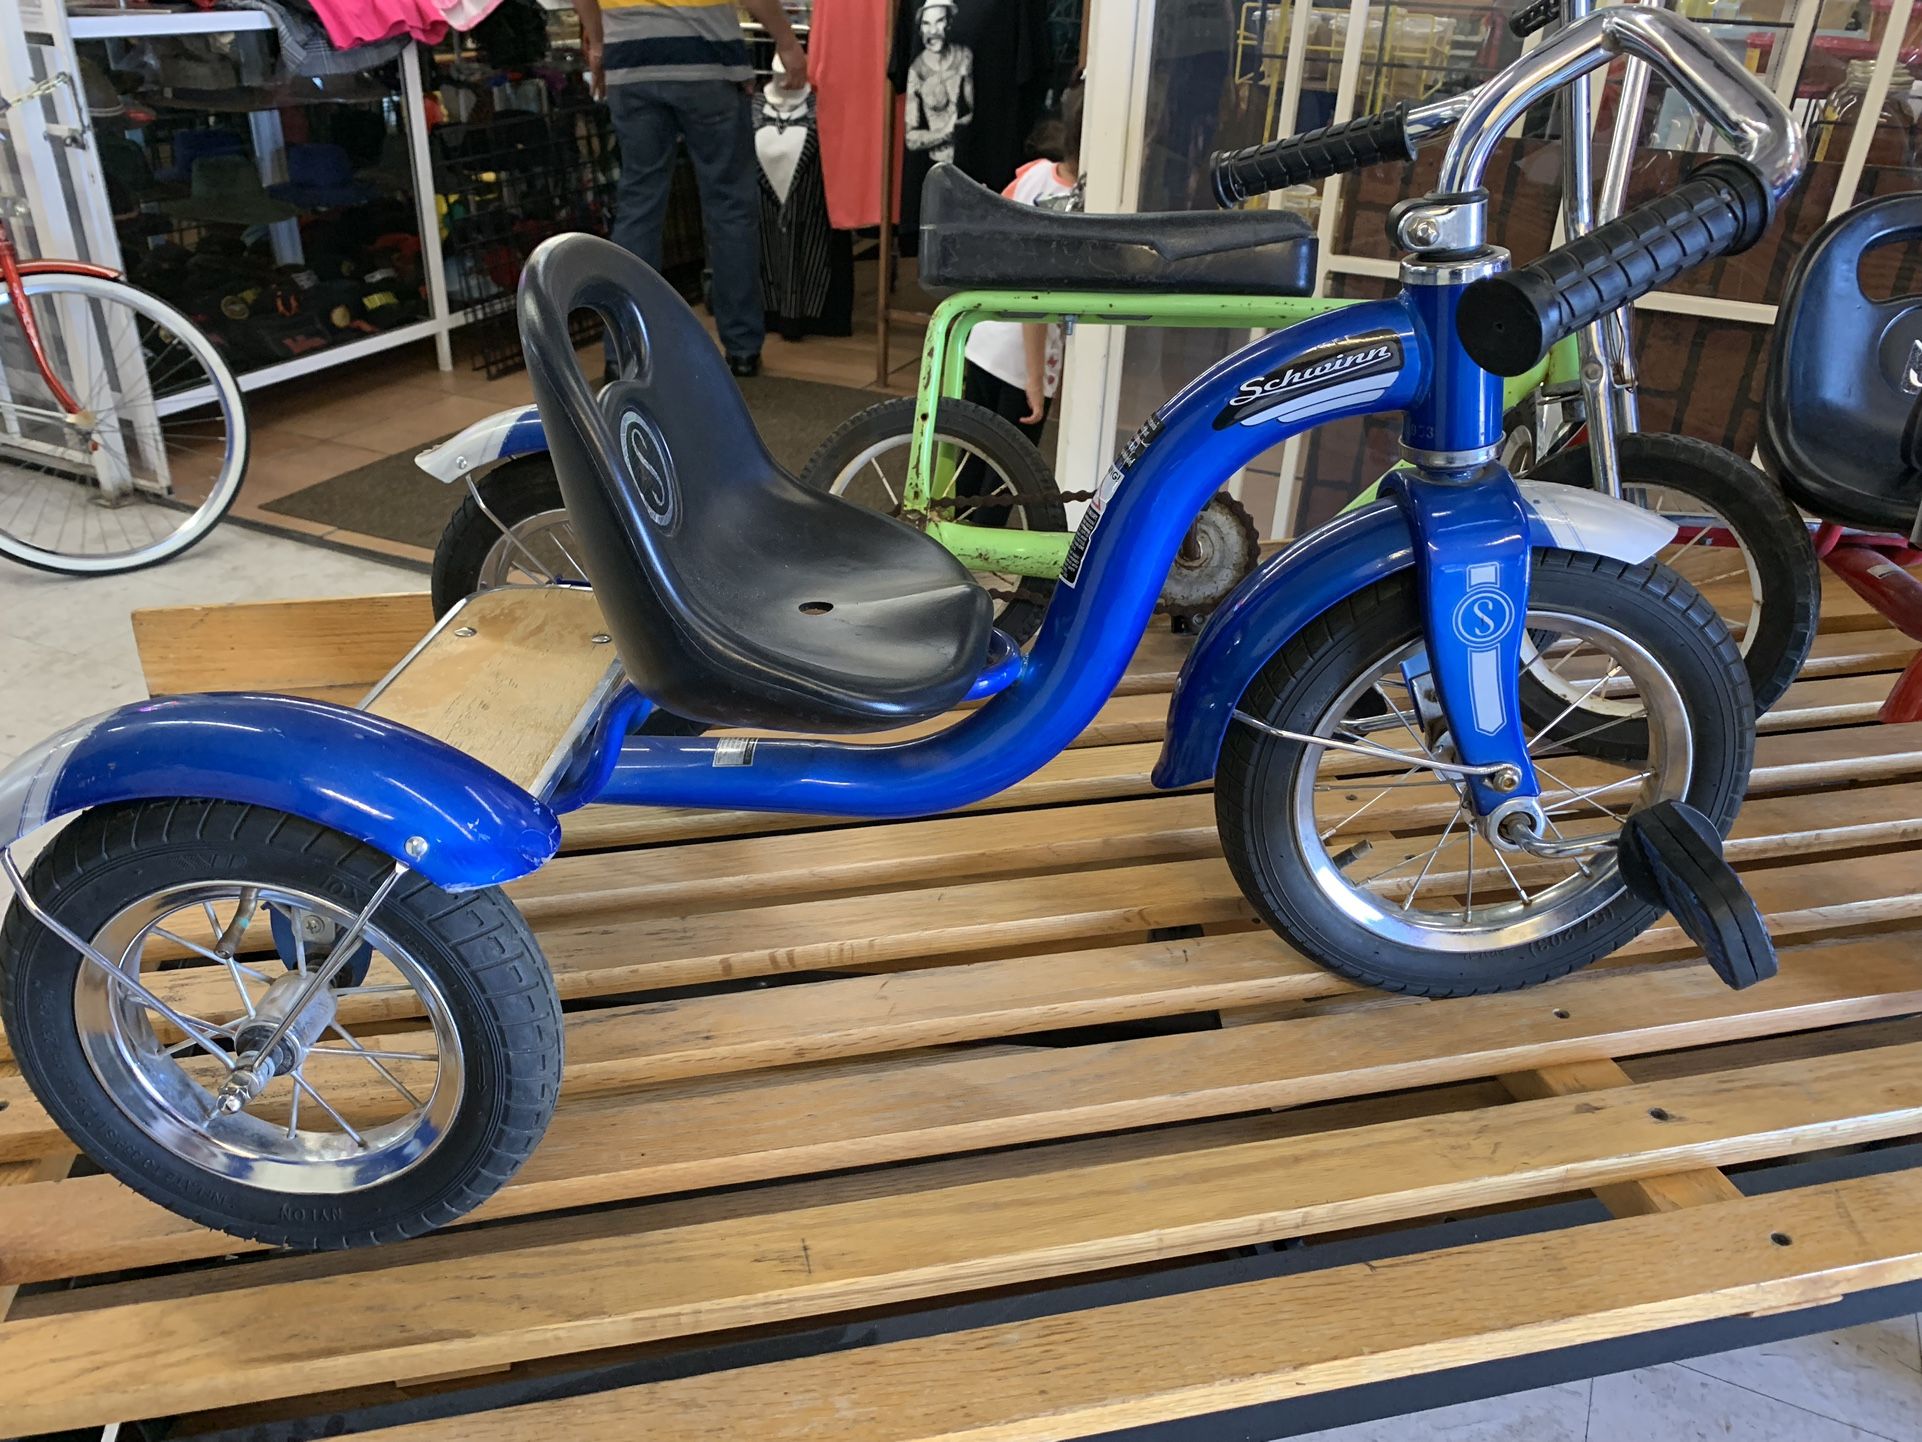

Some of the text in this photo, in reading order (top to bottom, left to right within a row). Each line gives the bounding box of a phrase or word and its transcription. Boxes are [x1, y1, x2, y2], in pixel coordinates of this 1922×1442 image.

[1229, 345, 1392, 407] Schwinn
[1473, 599, 1496, 636] S
[279, 1206, 344, 1222] NYLON
